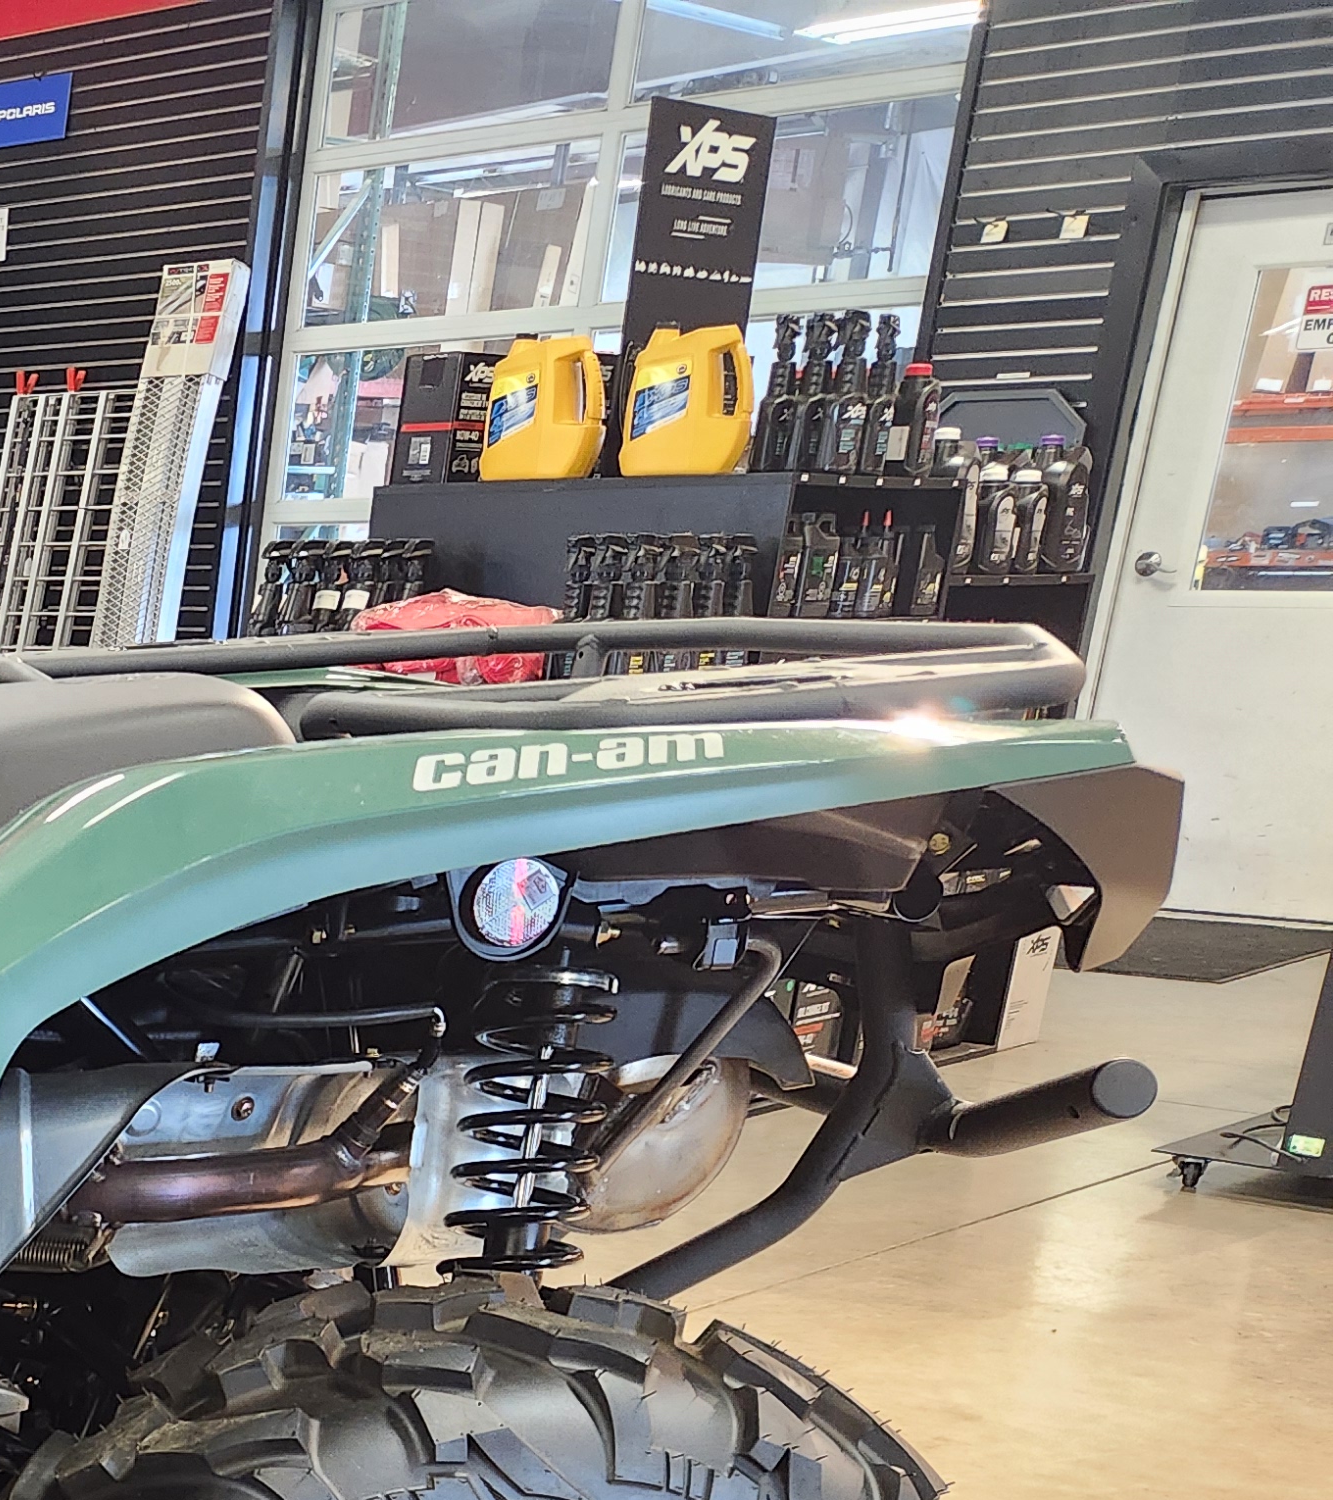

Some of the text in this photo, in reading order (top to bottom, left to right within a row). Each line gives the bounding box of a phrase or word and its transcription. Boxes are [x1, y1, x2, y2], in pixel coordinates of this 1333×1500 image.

[664, 118, 757, 183] XPS
[464, 362, 495, 383] XPS
[412, 732, 725, 792] can-am
